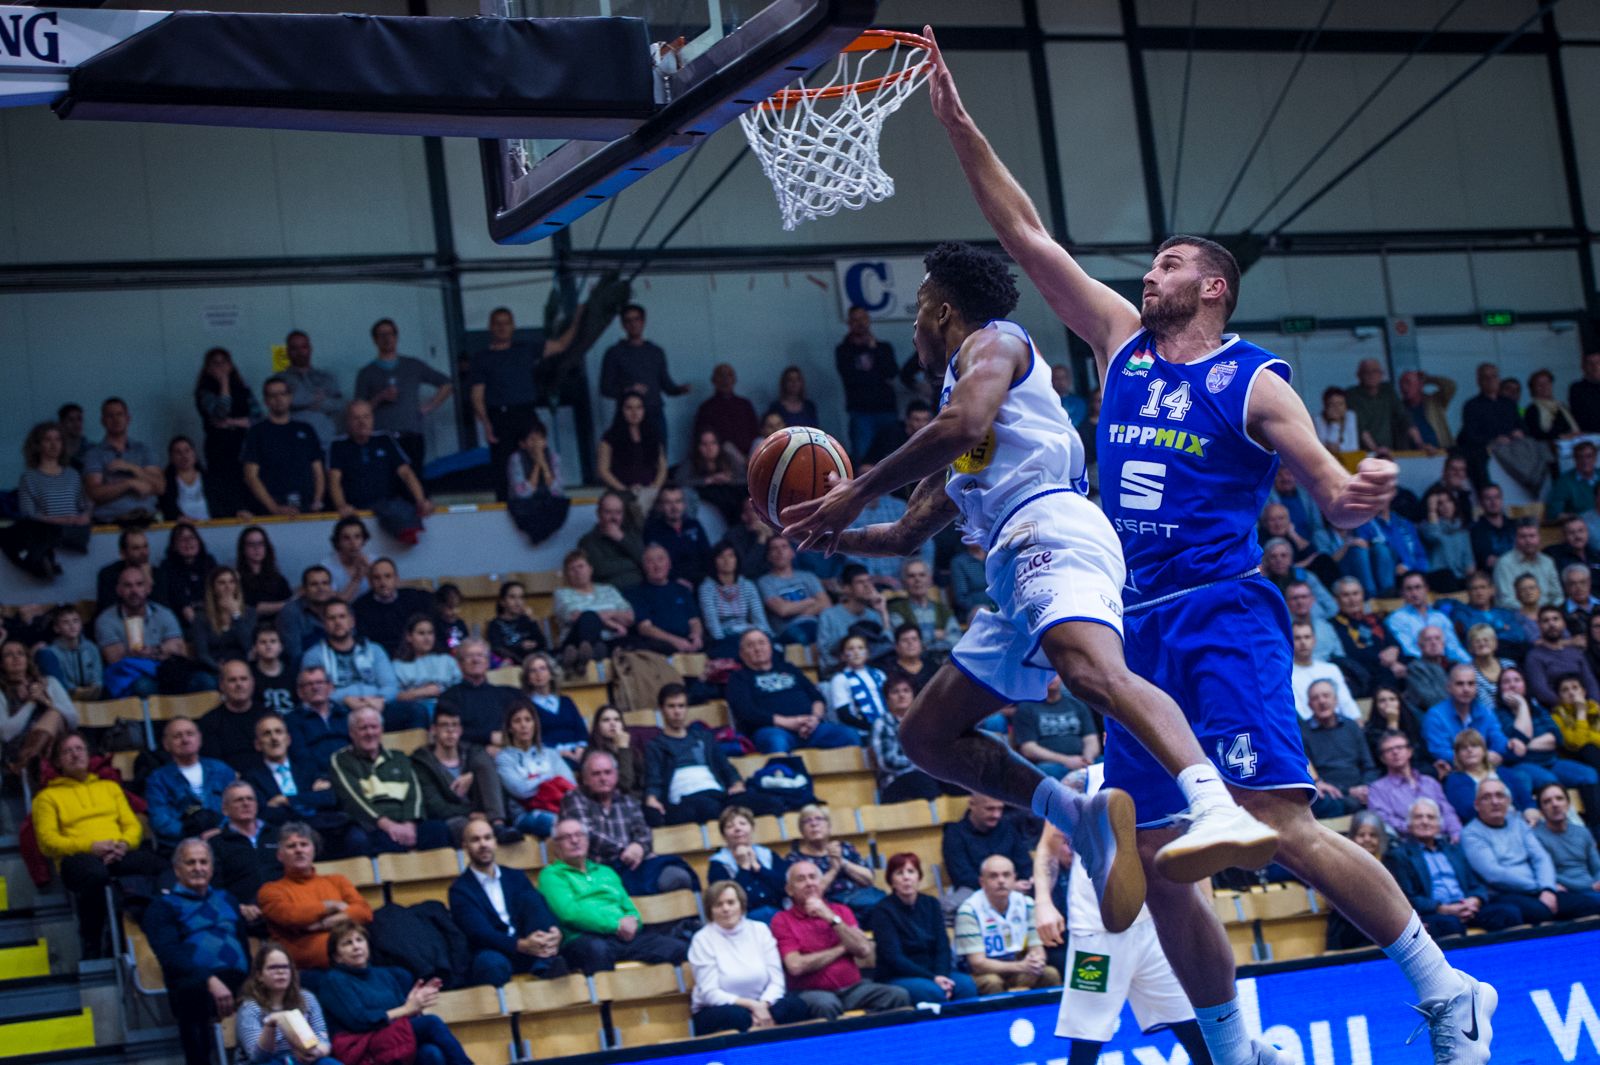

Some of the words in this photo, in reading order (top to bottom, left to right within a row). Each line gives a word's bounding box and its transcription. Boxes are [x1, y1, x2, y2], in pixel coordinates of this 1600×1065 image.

[846, 262, 890, 312] C
[1139, 378, 1192, 421] 14
[1114, 518, 1179, 538] SEAT
[984, 934, 1004, 953] 50
